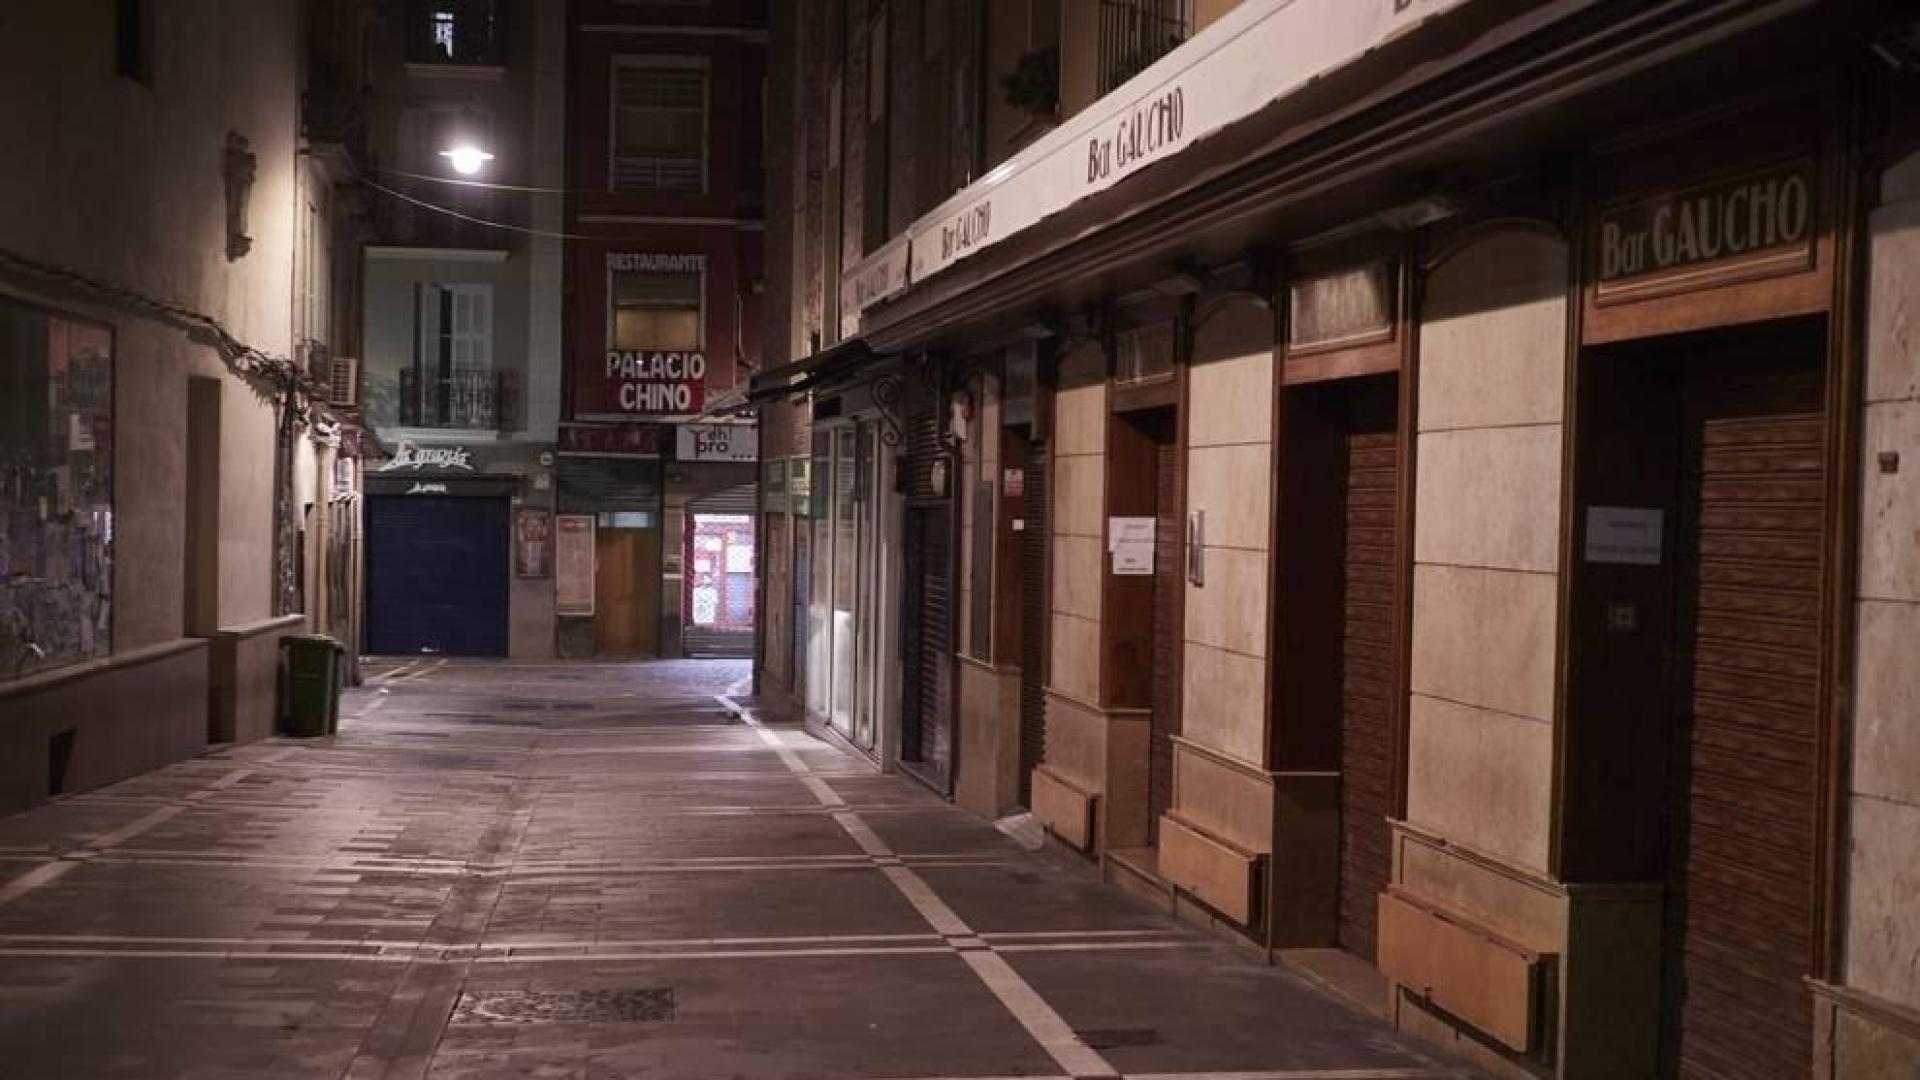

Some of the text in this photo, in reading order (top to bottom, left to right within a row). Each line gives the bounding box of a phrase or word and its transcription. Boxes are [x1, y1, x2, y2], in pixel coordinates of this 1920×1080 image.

[1087, 86, 1184, 183] Bar GAUCHO
[1602, 175, 1808, 279] Bar GAUCHO
[606, 253, 707, 272] RESTAURANTE
[606, 352, 706, 379] PALACIO
[619, 382, 692, 411] CHINO
